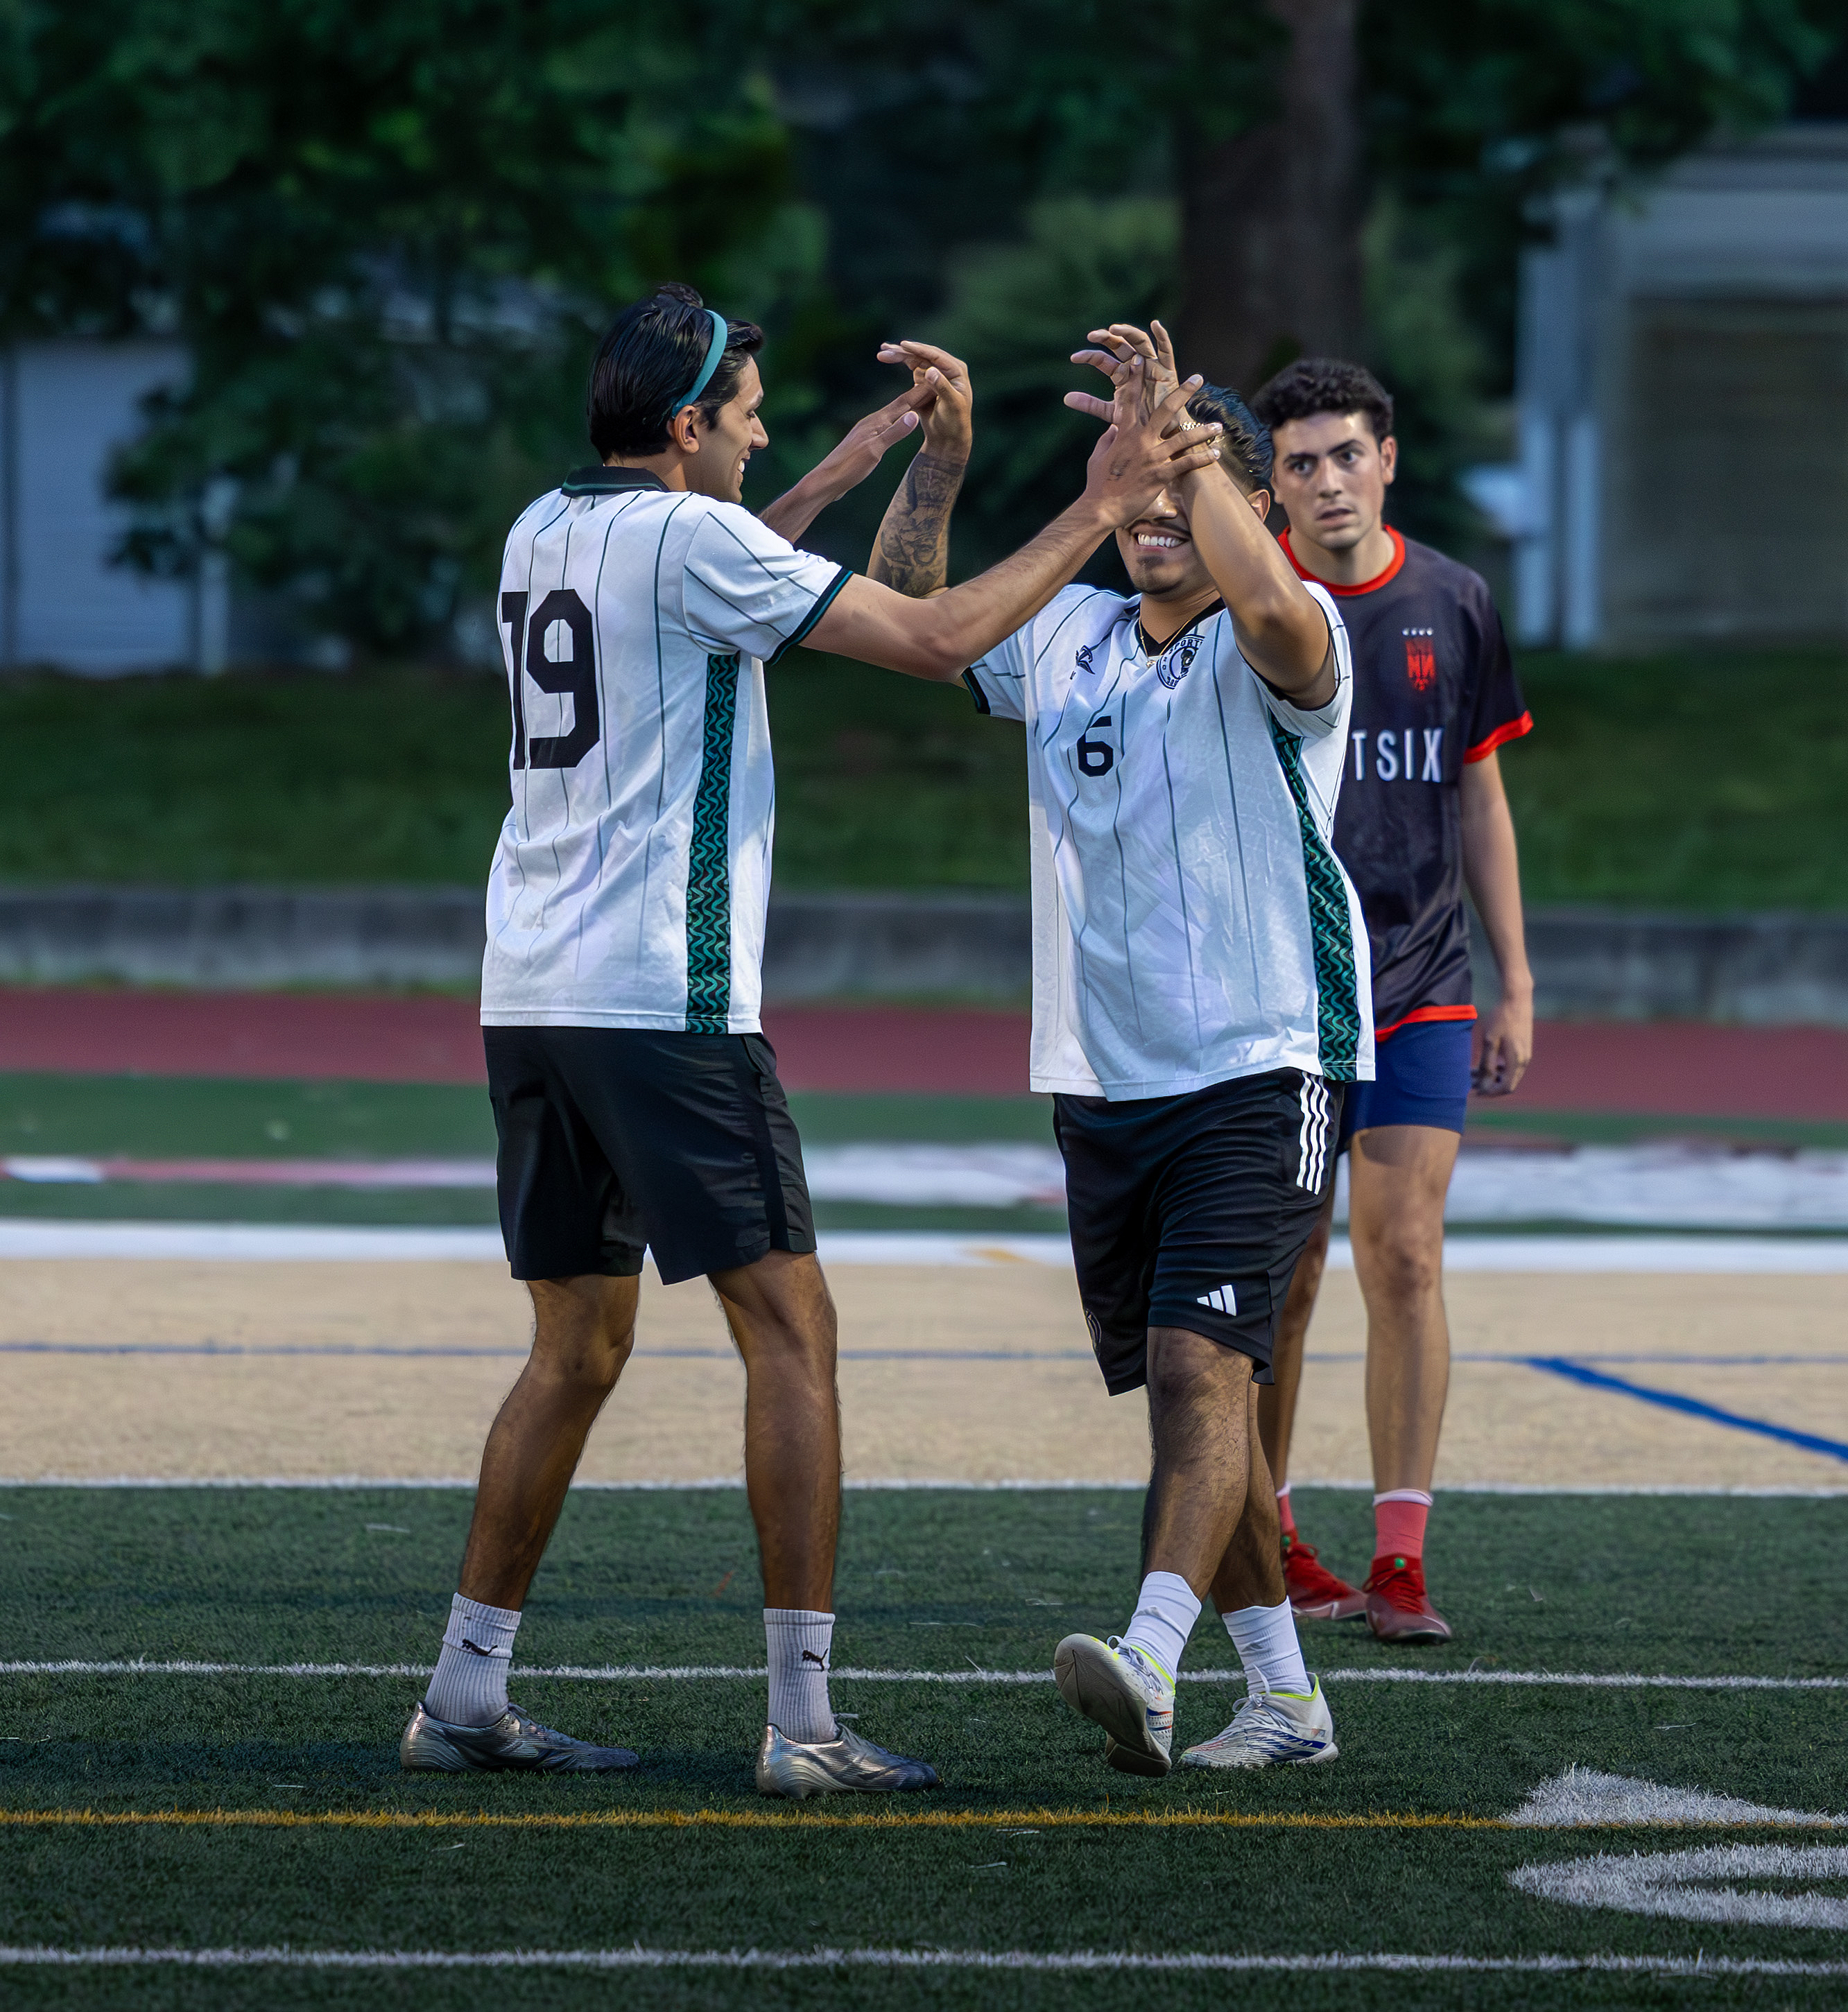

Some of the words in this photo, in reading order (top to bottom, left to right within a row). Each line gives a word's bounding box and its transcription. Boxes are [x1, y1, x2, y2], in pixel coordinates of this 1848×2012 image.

[501, 588, 601, 770] 19
[1076, 715, 1114, 777] 6
[1342, 728, 1443, 783] TSIX
